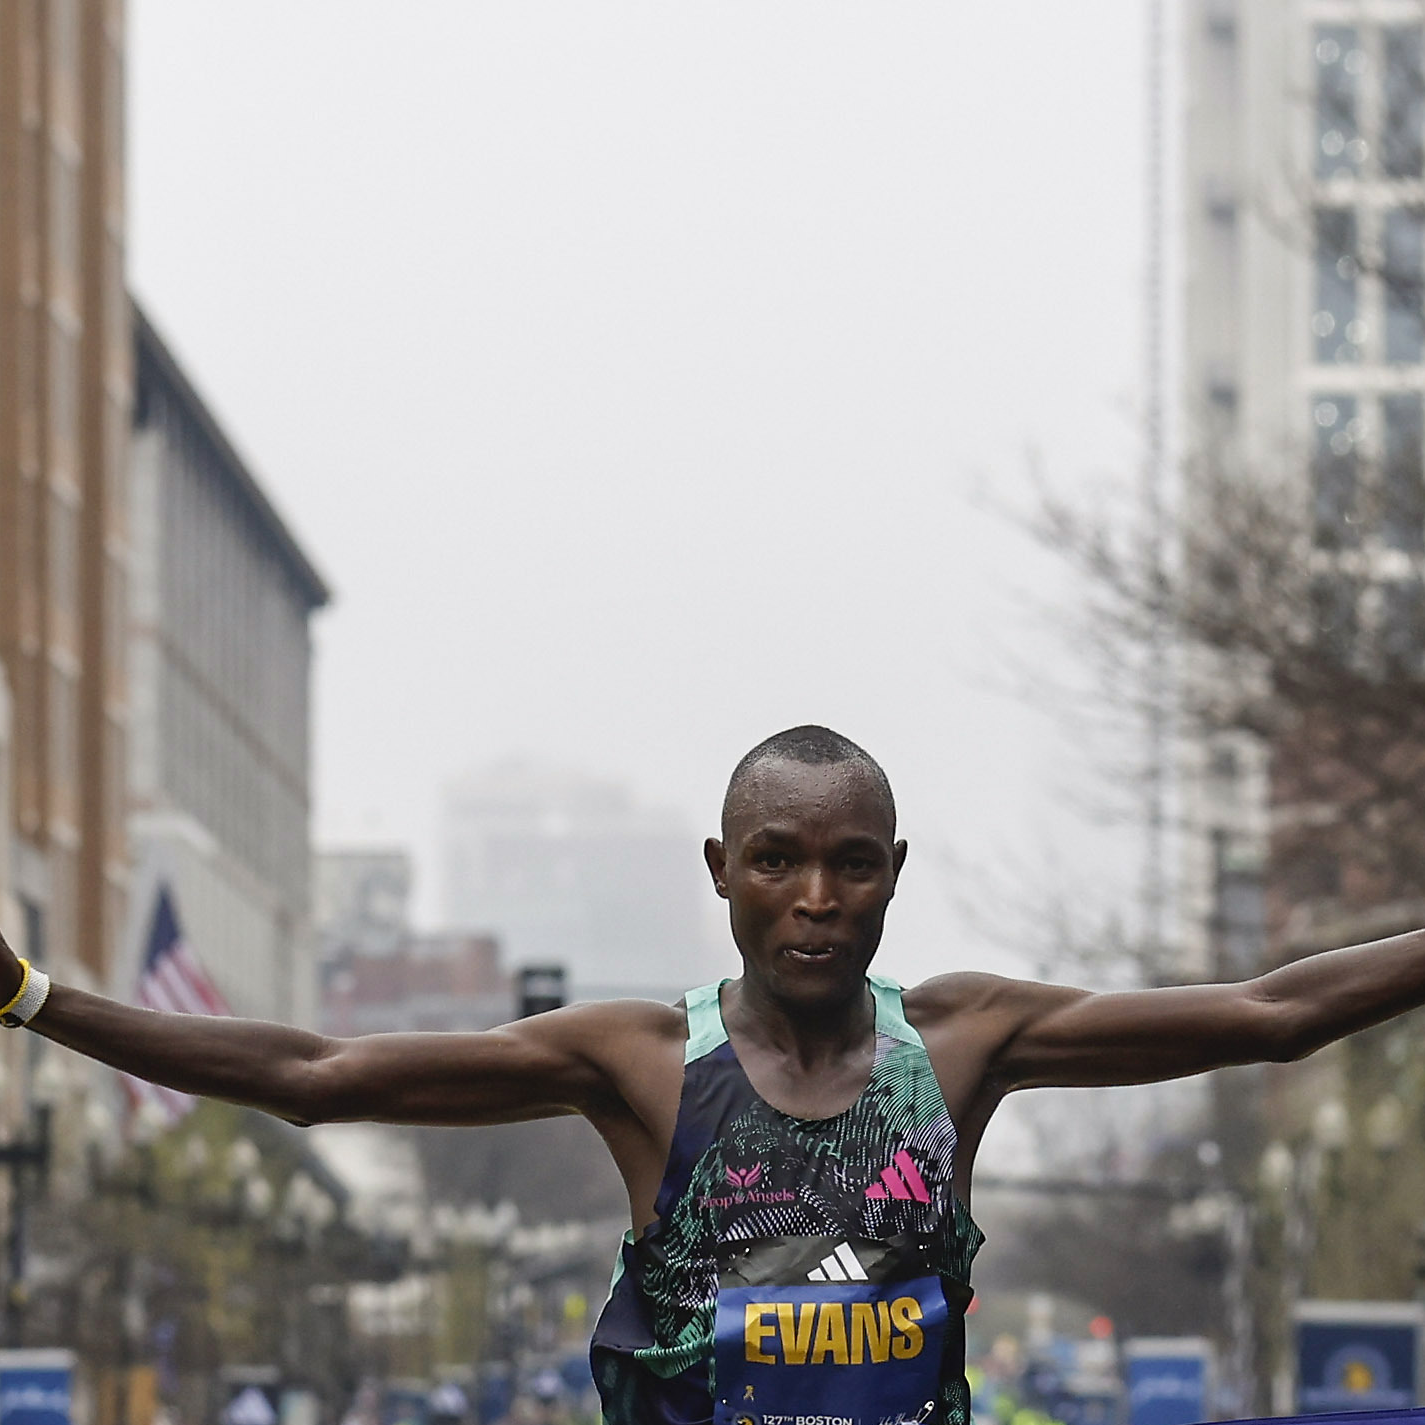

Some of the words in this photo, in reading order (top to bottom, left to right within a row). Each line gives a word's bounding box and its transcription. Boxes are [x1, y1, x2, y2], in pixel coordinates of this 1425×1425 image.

[744, 1188, 795, 1204] Angels
[745, 1297, 924, 1366] EVANS
[762, 1414, 794, 1425] 127TH
